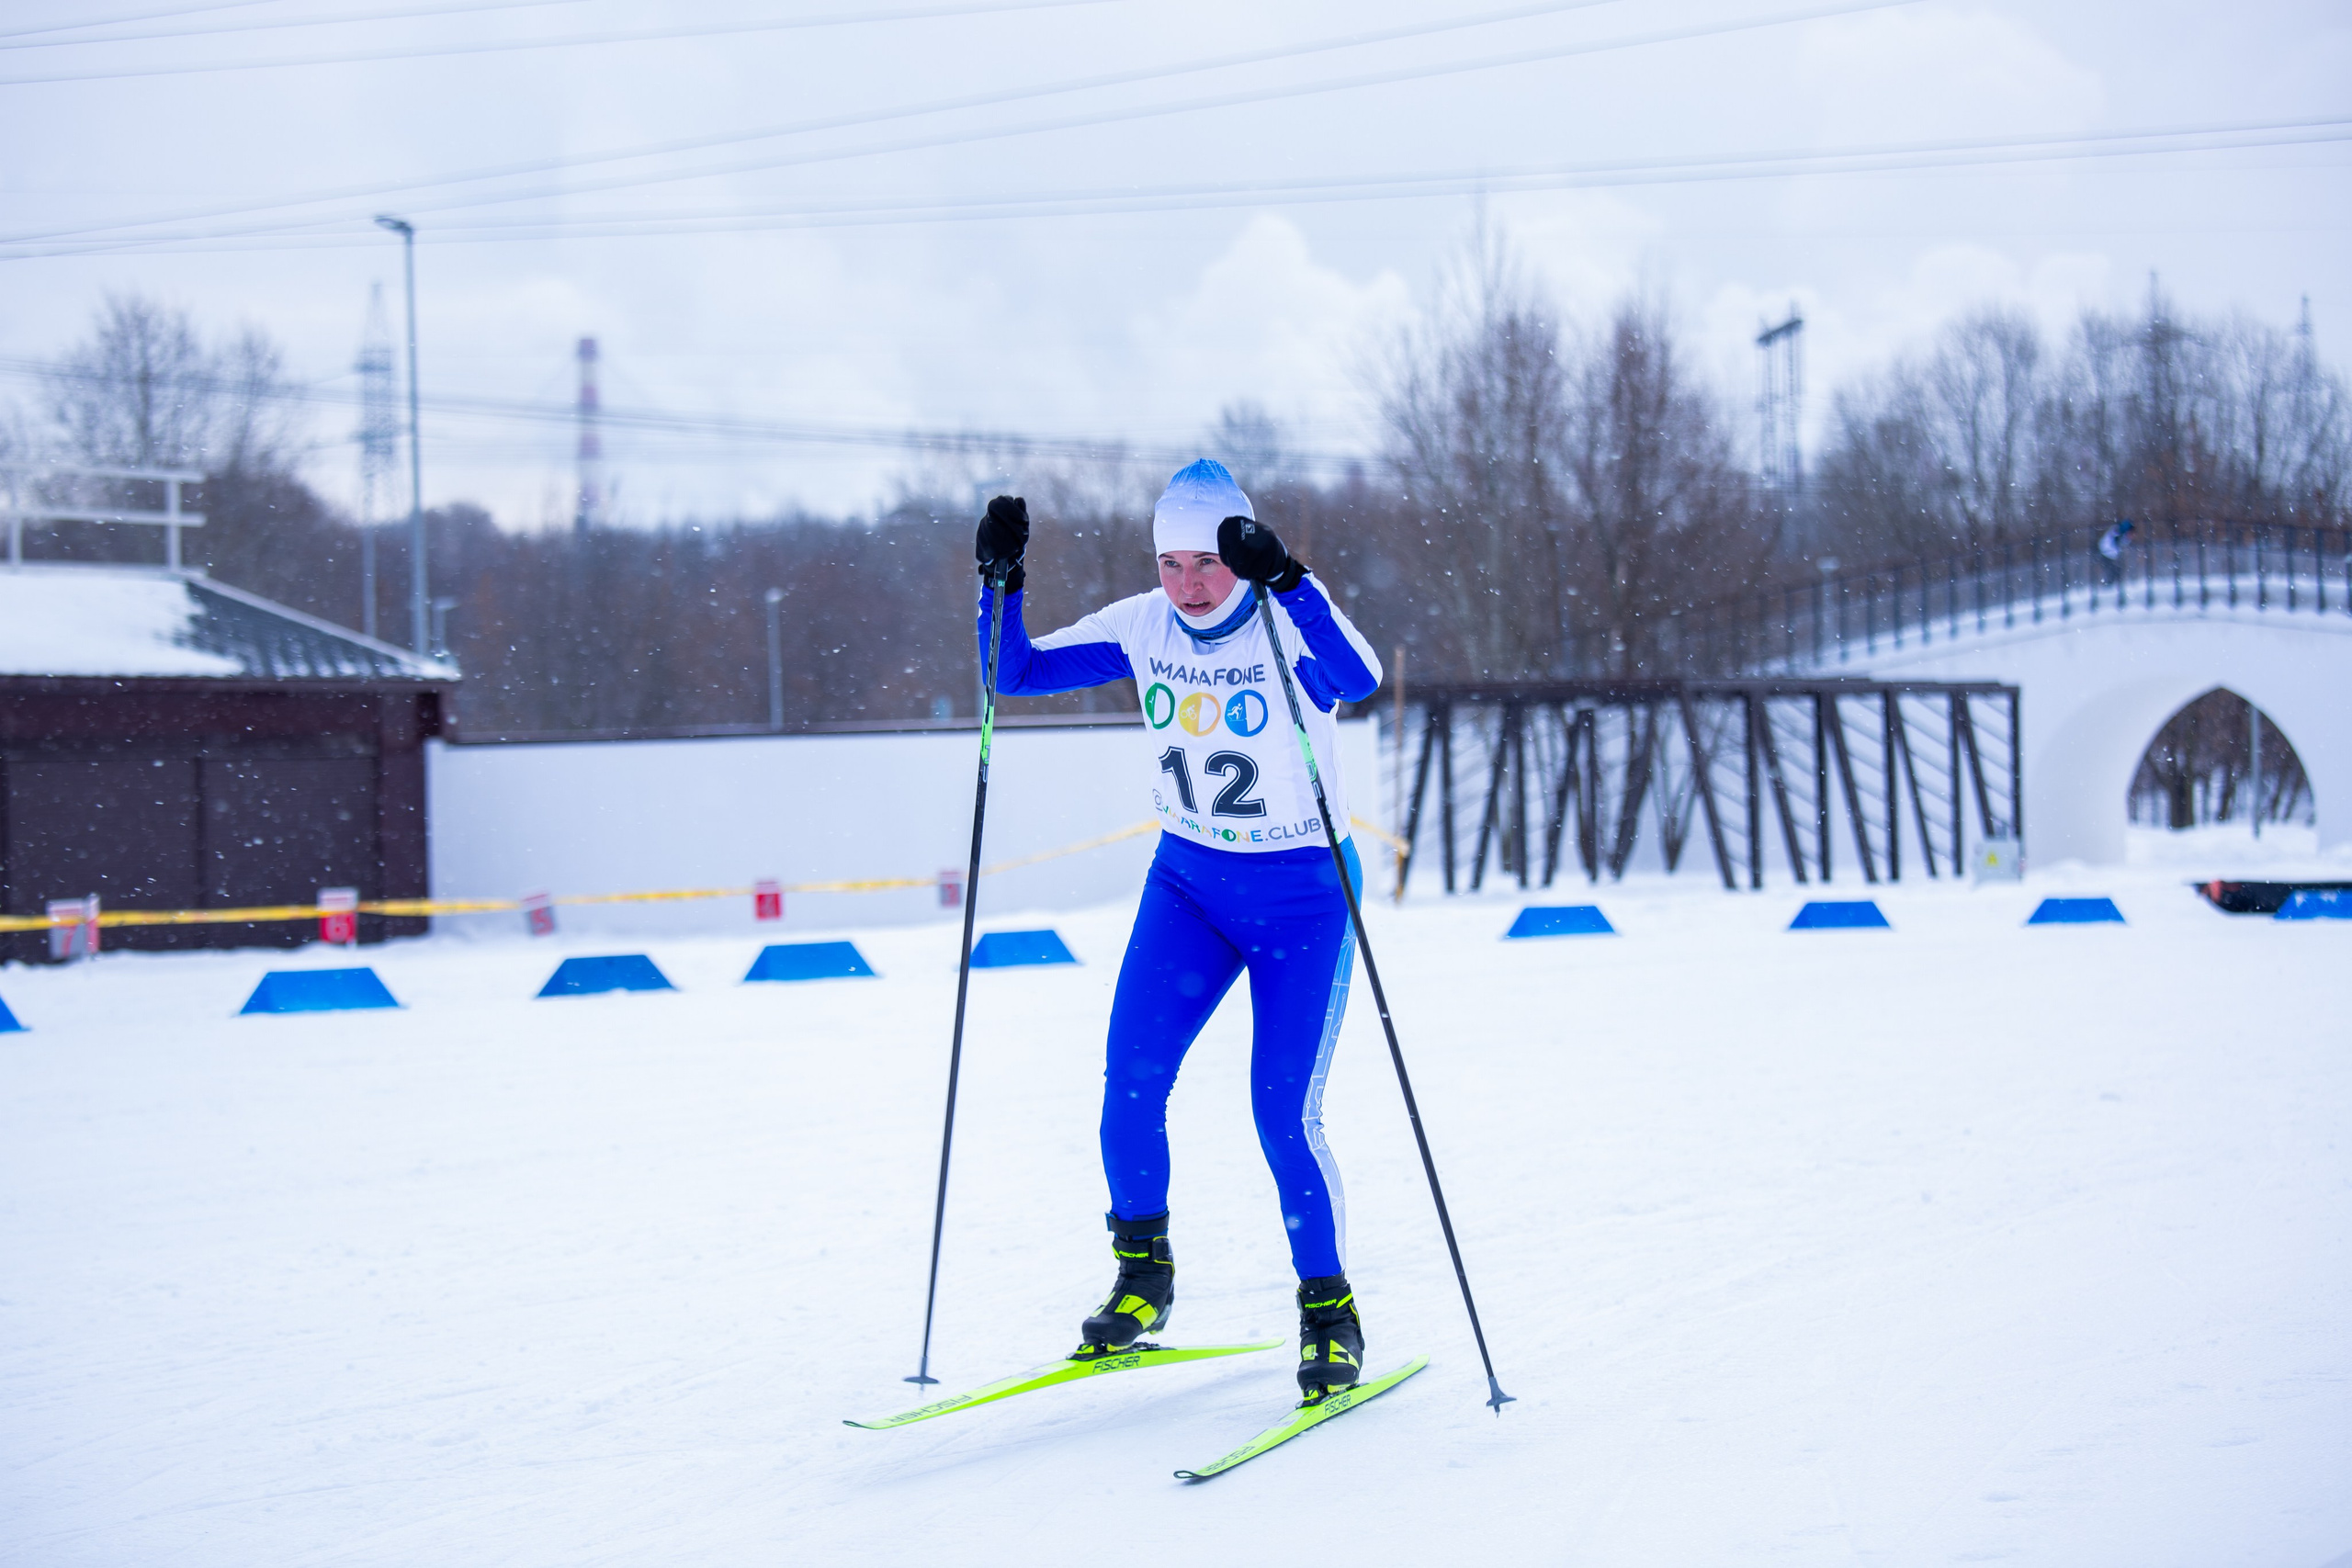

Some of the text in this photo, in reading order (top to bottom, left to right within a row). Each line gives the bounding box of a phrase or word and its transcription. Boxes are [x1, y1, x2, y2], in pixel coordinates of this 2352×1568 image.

[1159, 746, 1267, 818] 12
[1092, 1355, 1141, 1373] FISCHER
[884, 1394, 973, 1423] FISCHER
[1324, 1393, 1352, 1416] FISCHER
